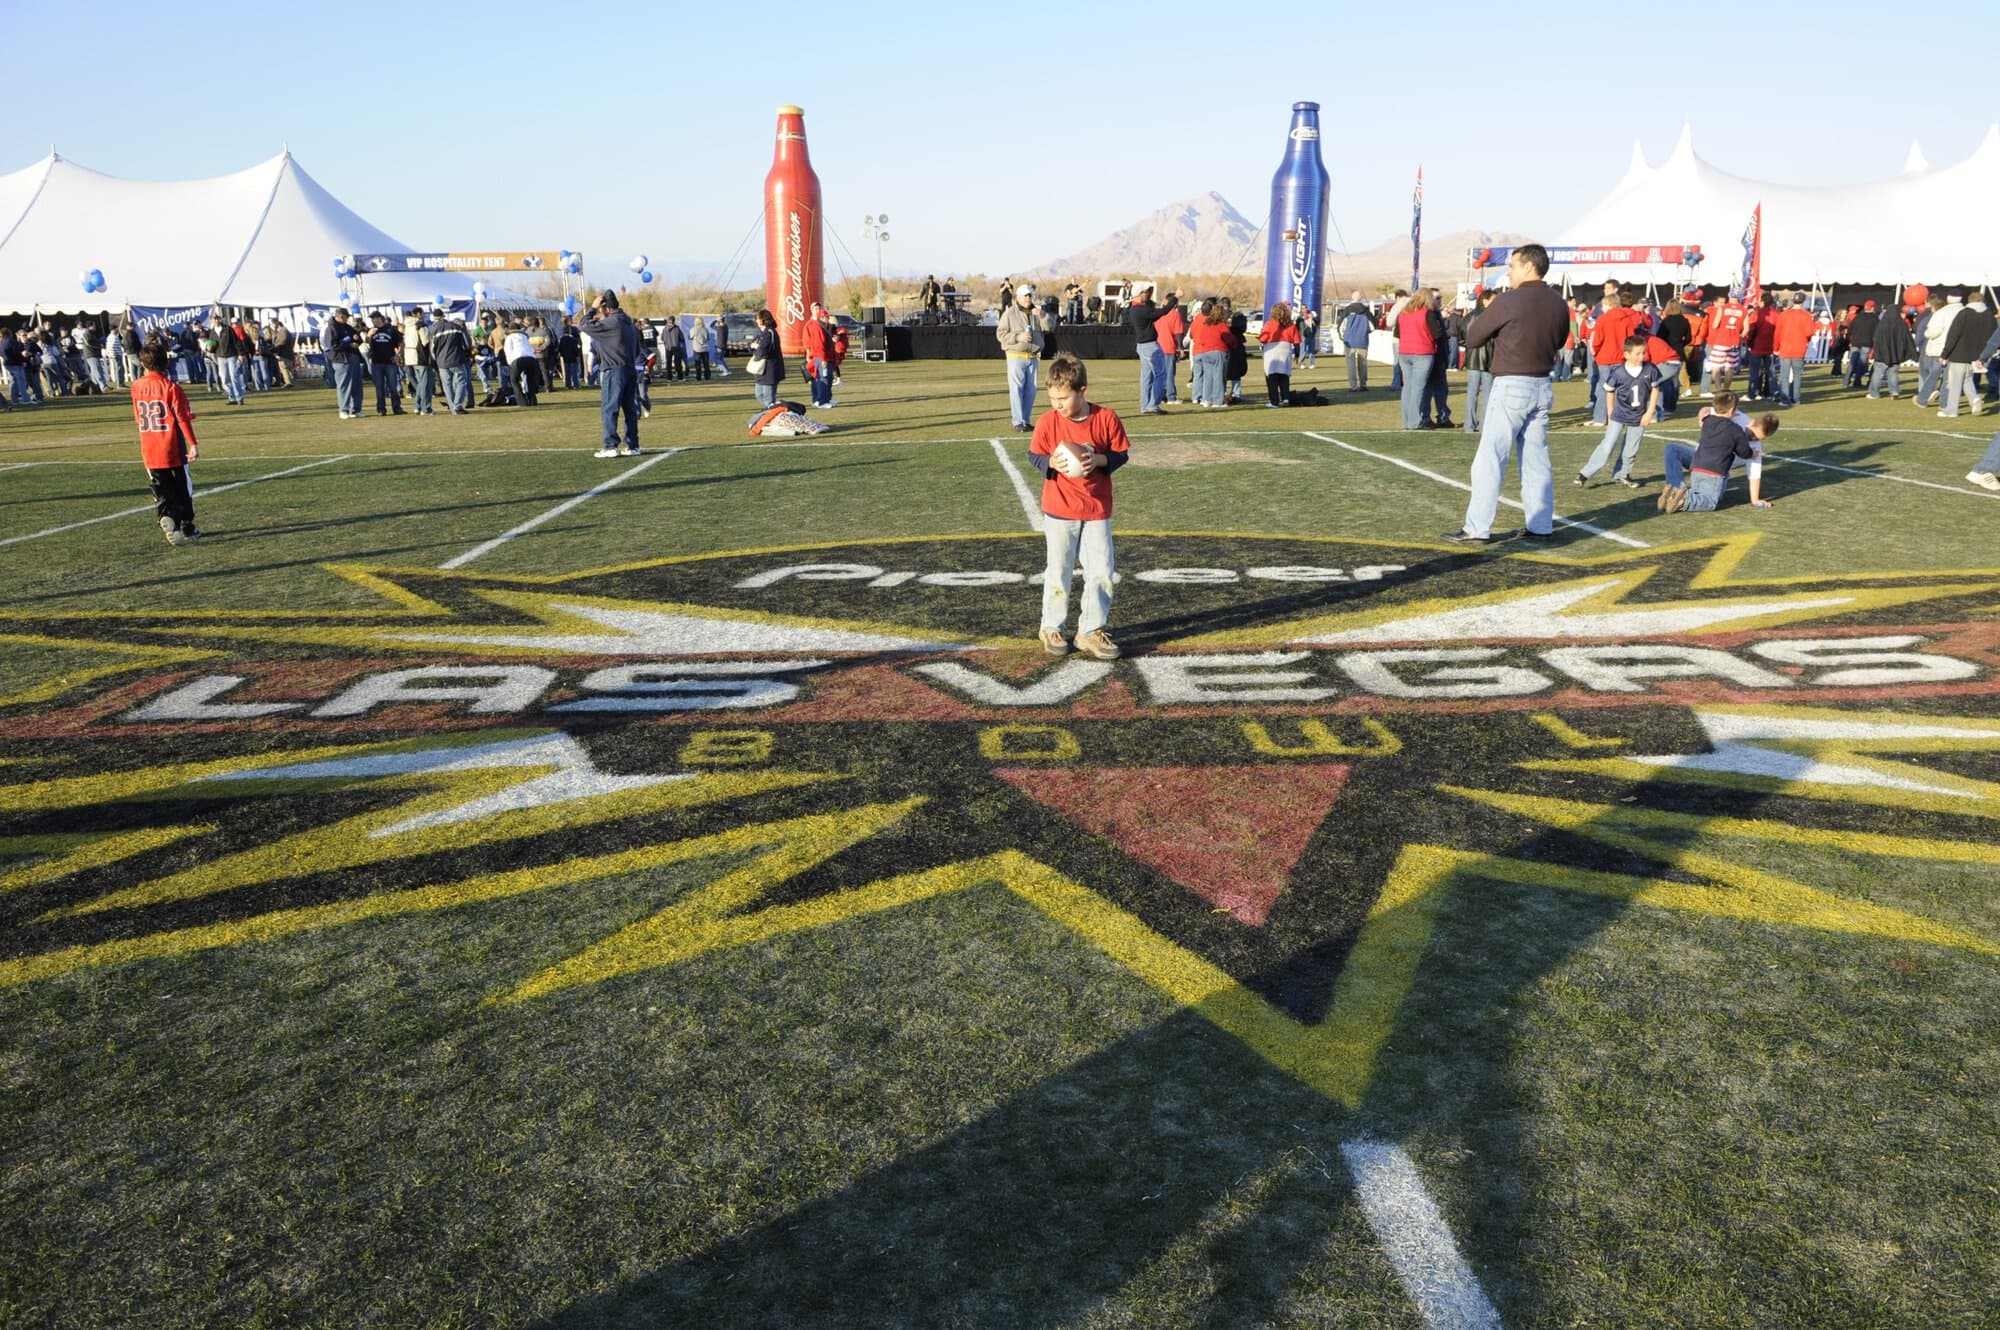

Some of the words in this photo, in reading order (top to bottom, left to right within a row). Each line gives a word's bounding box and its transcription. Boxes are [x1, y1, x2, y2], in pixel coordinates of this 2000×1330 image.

[1294, 217, 1307, 278] LIGHT
[1553, 250, 1609, 263] HOSPITALITY
[1610, 250, 1632, 262] TENT
[406, 257, 423, 269] VIP
[423, 257, 482, 269] HOSPITALITY
[483, 256, 506, 268] TENT
[785, 211, 805, 325] Budweiser
[137, 307, 202, 331] Welcome
[1631, 384, 1641, 408] 1
[137, 400, 169, 432] 32
[125, 661, 842, 721] LAS
[914, 635, 1978, 705] VEGAS
